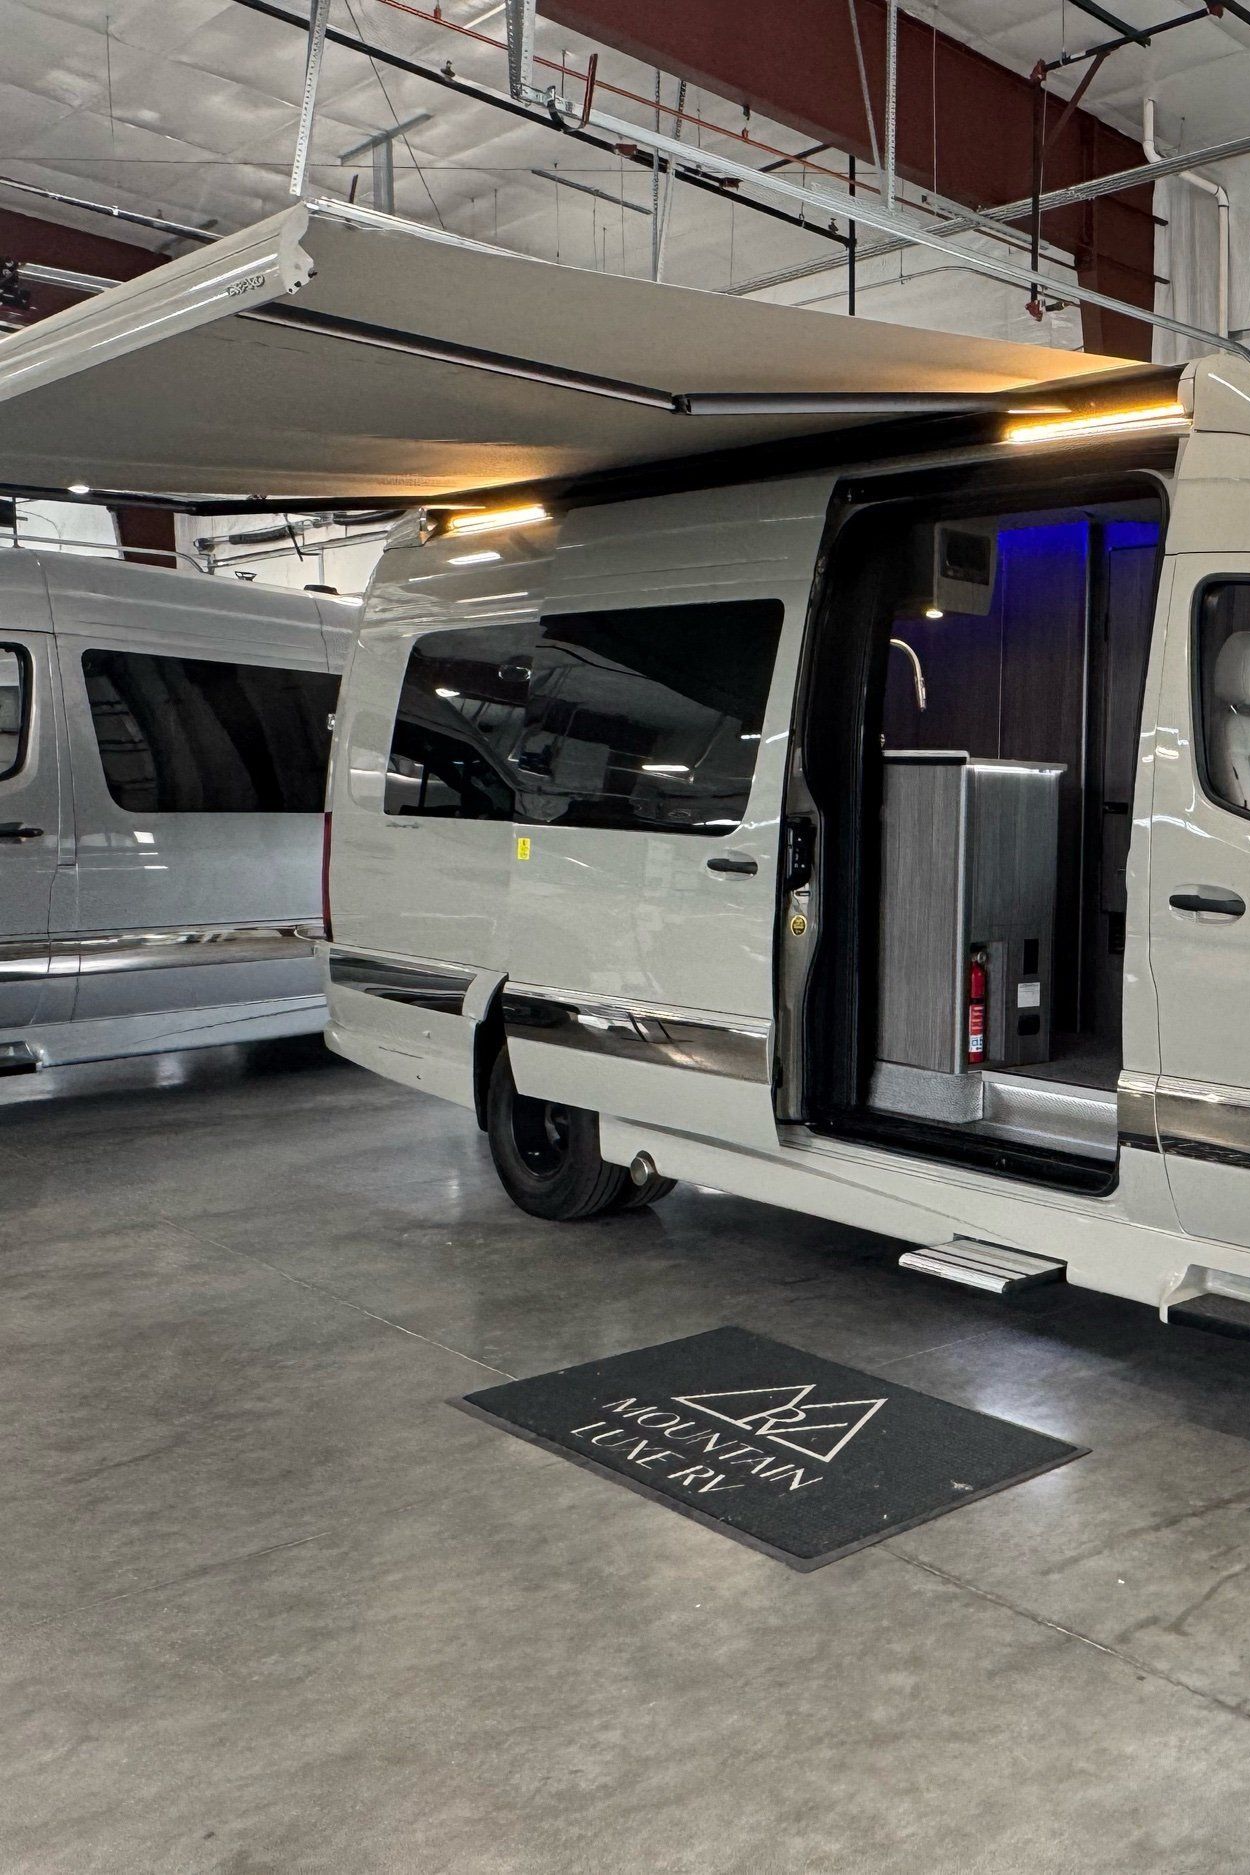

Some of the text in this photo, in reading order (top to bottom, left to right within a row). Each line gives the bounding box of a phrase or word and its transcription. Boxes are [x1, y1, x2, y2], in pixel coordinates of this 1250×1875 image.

[570, 1420, 745, 1494] LUXE RV
[601, 1397, 824, 1491] MOUNTAIN
